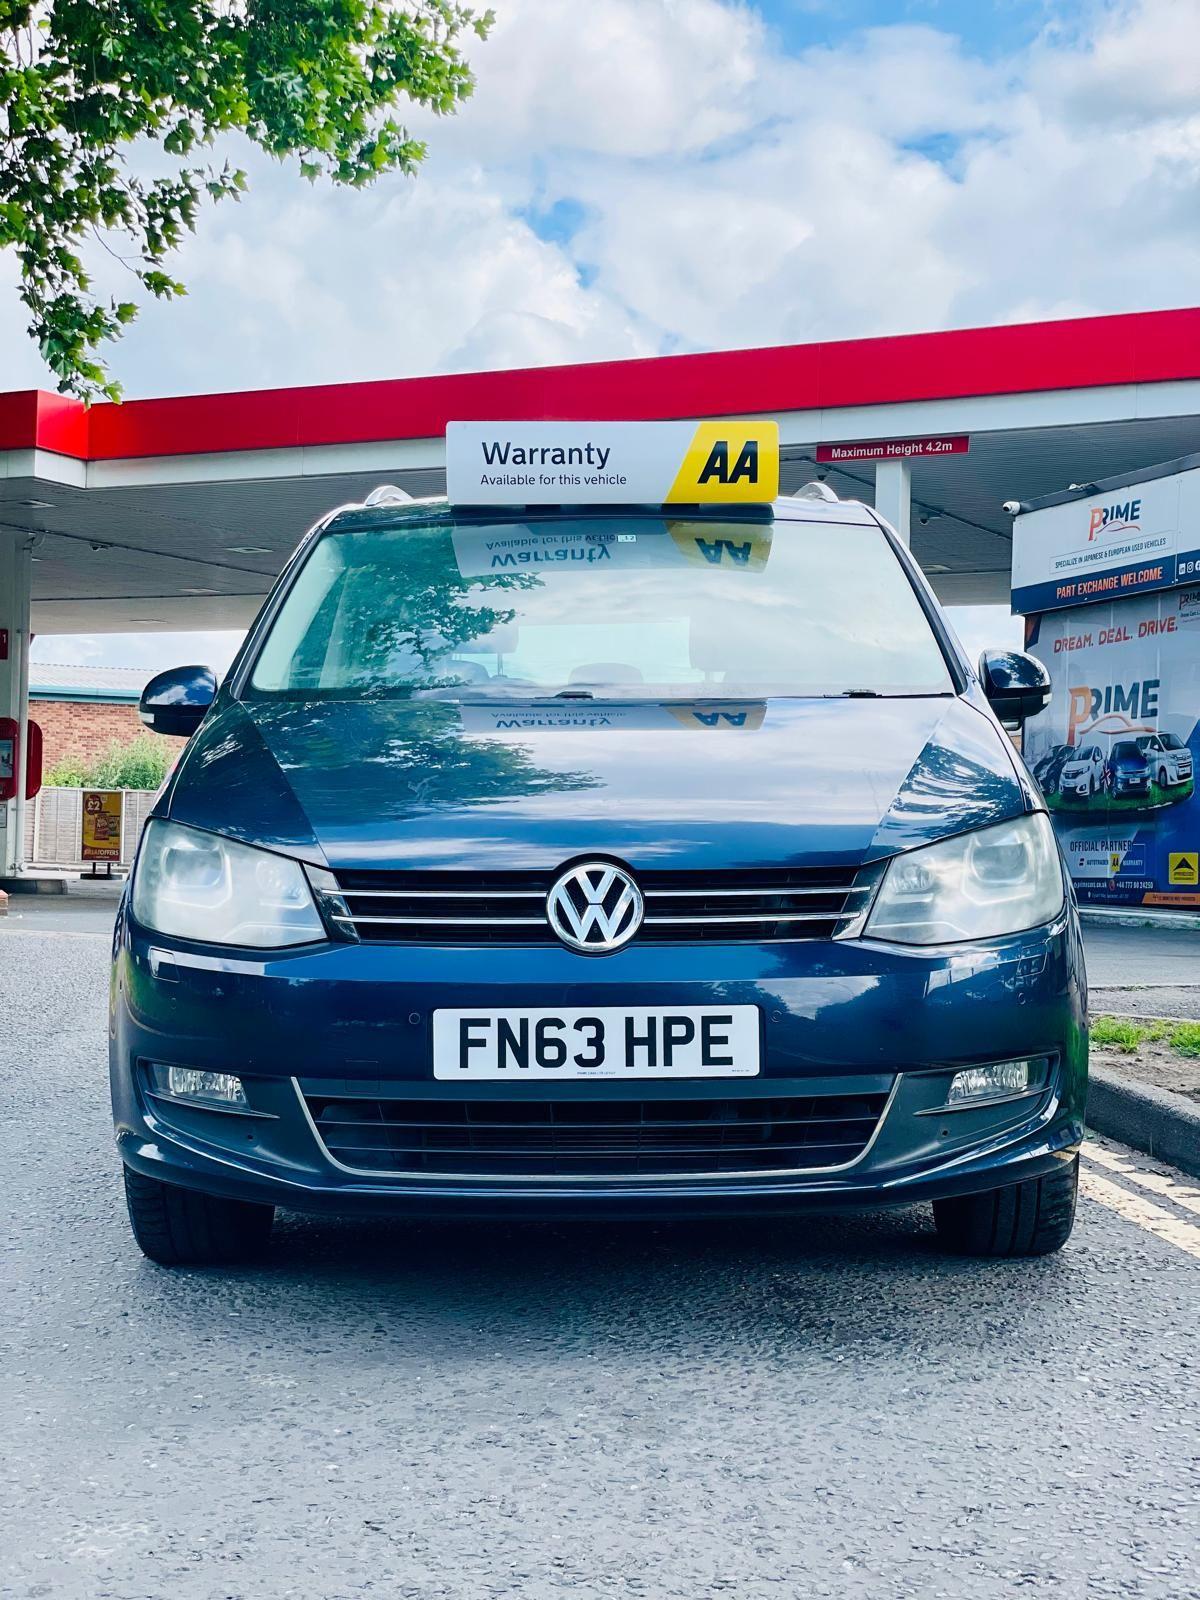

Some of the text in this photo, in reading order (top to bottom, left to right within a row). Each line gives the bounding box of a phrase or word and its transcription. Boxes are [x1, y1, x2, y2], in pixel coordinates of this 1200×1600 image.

[481, 441, 611, 470] Warranty
[697, 440, 758, 484] AA
[831, 441, 953, 459] Maximum Height 4.2m
[480, 473, 627, 485] Available for this vehicle
[1087, 499, 1142, 541] PRIME
[1055, 556, 1078, 569] SPECIALIZE
[1078, 556, 1083, 564] IN
[1083, 551, 1104, 563] JAPANESE
[1108, 546, 1131, 558] EUROPEAN
[1131, 543, 1144, 552] USED
[1143, 537, 1167, 550] VEHICLES
[1055, 566, 1164, 600] PART EXCHANGE WELCOME
[1053, 616, 1178, 654] DREAM. DEAL. DRIVE.
[1067, 679, 1161, 746] PRIME
[87, 800, 101, 811] £2
[1070, 840, 1132, 852] OFFICIAL PARTNER
[459, 1015, 734, 1069] FN63 HPE
